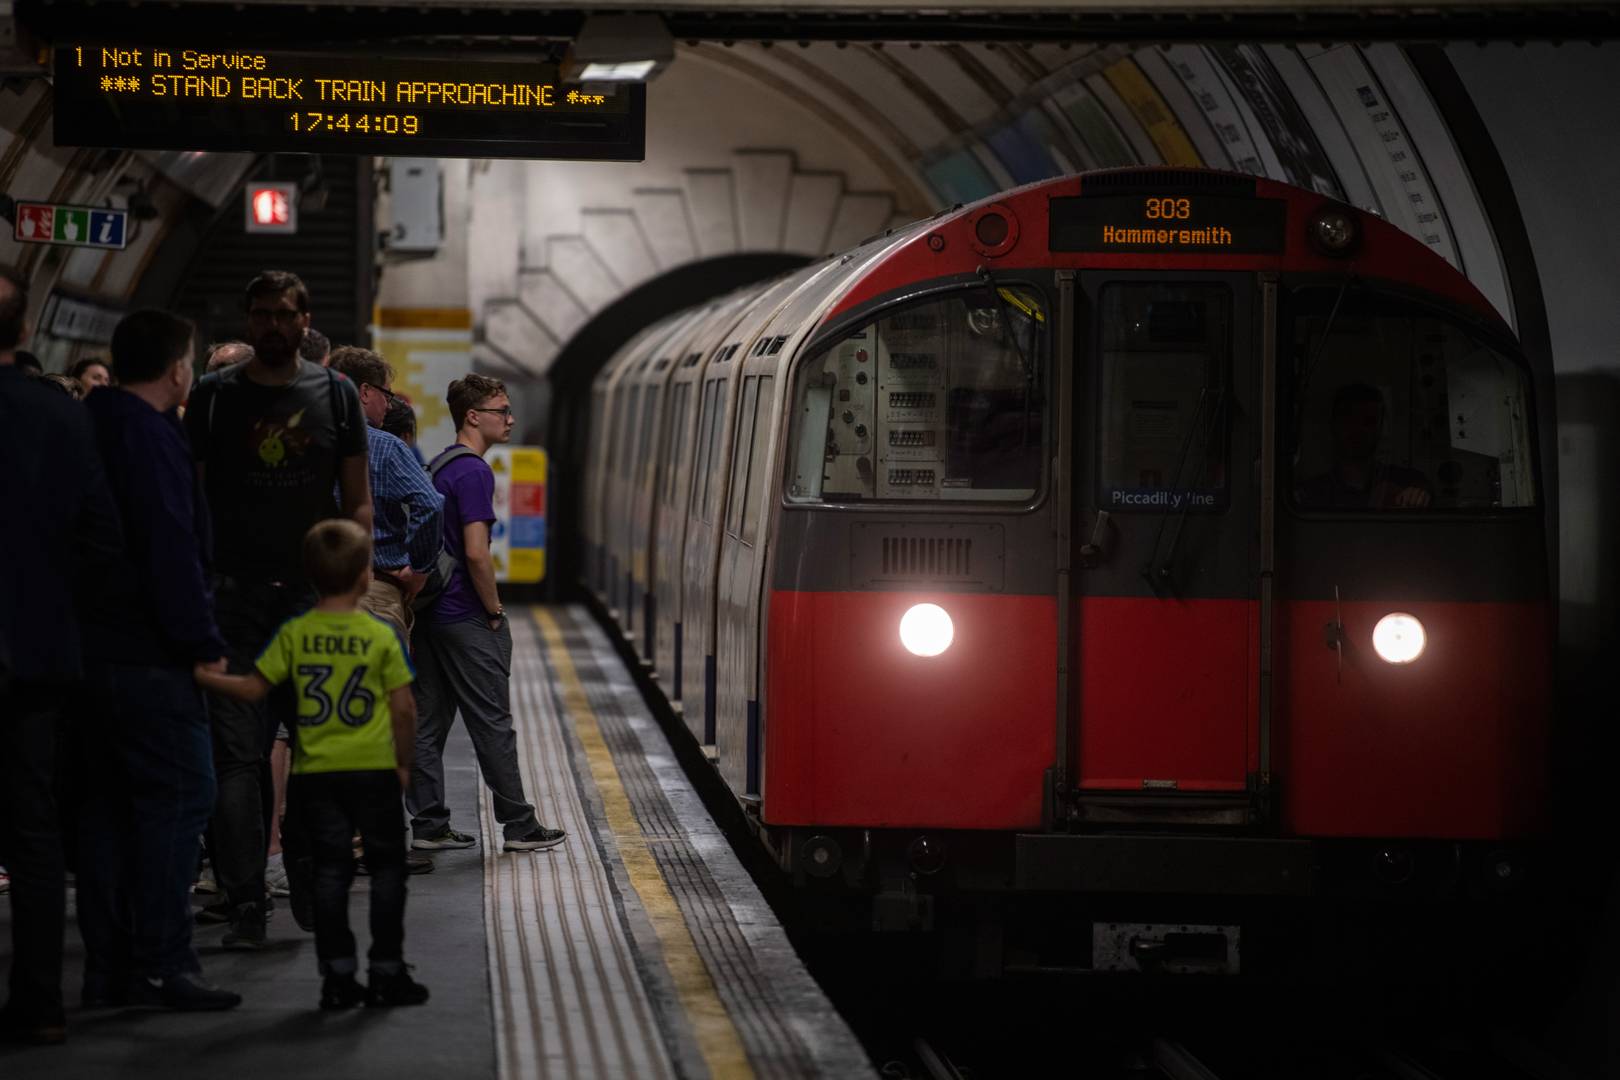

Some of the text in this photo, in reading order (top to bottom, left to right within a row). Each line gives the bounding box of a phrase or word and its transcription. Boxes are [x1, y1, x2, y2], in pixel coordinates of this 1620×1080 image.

[75, 46, 266, 71] 1 Not in Service
[152, 74, 231, 98] STAND
[241, 76, 303, 100] BACK
[315, 79, 386, 102] TRAIN
[290, 111, 419, 135] 17:44:09
[1145, 197, 1191, 220] 303
[1103, 225, 1233, 245] Hammersmith
[302, 634, 371, 656] LEDLEY
[296, 664, 375, 727] 36
